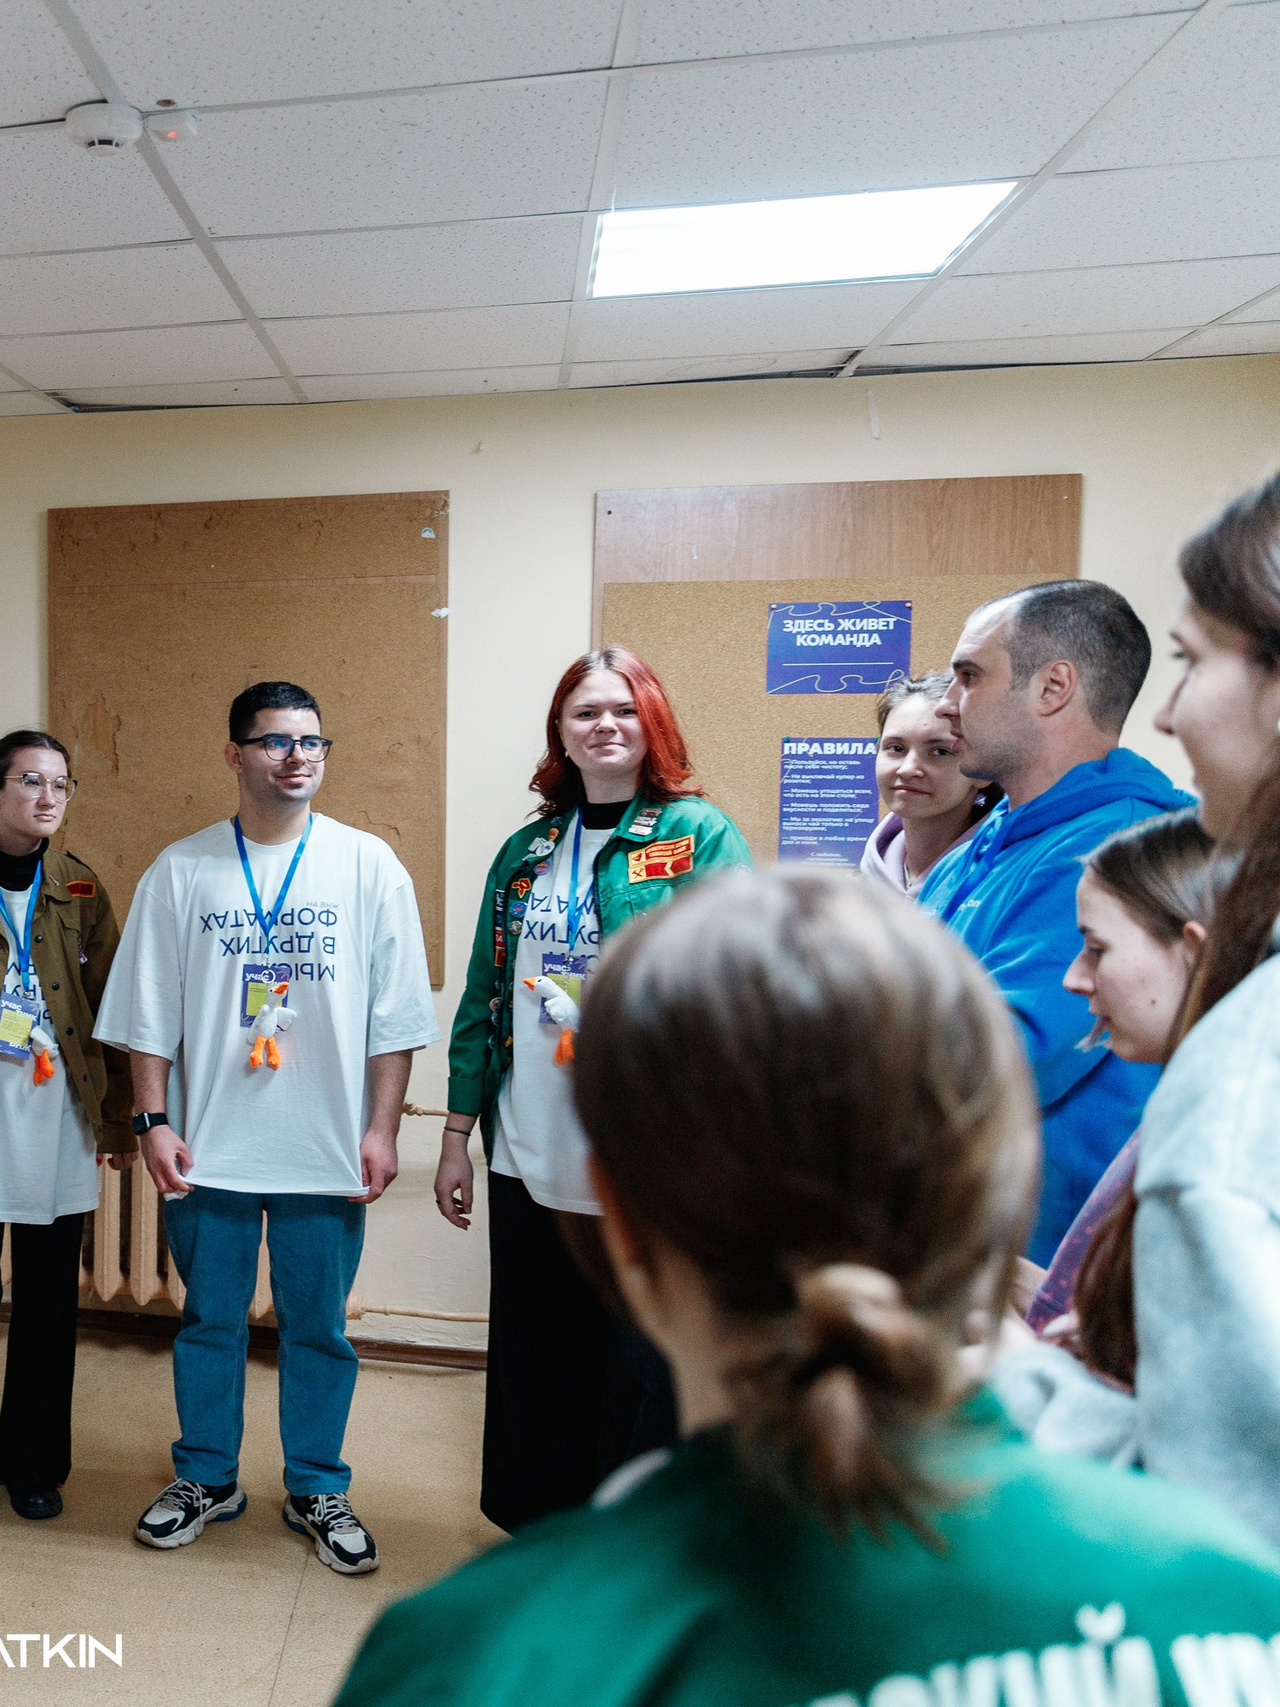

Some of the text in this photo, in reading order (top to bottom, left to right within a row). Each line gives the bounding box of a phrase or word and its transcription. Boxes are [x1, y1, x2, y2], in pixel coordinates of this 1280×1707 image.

[783, 618, 897, 633] ЗДЕСЬ ЖИВЕТ
[796, 633, 882, 648] КОМАНДА
[783, 742, 878, 755] ПРАВИЛА
[306, 901, 318, 909] НА
[220, 931, 336, 957] В ДРУГИХ
